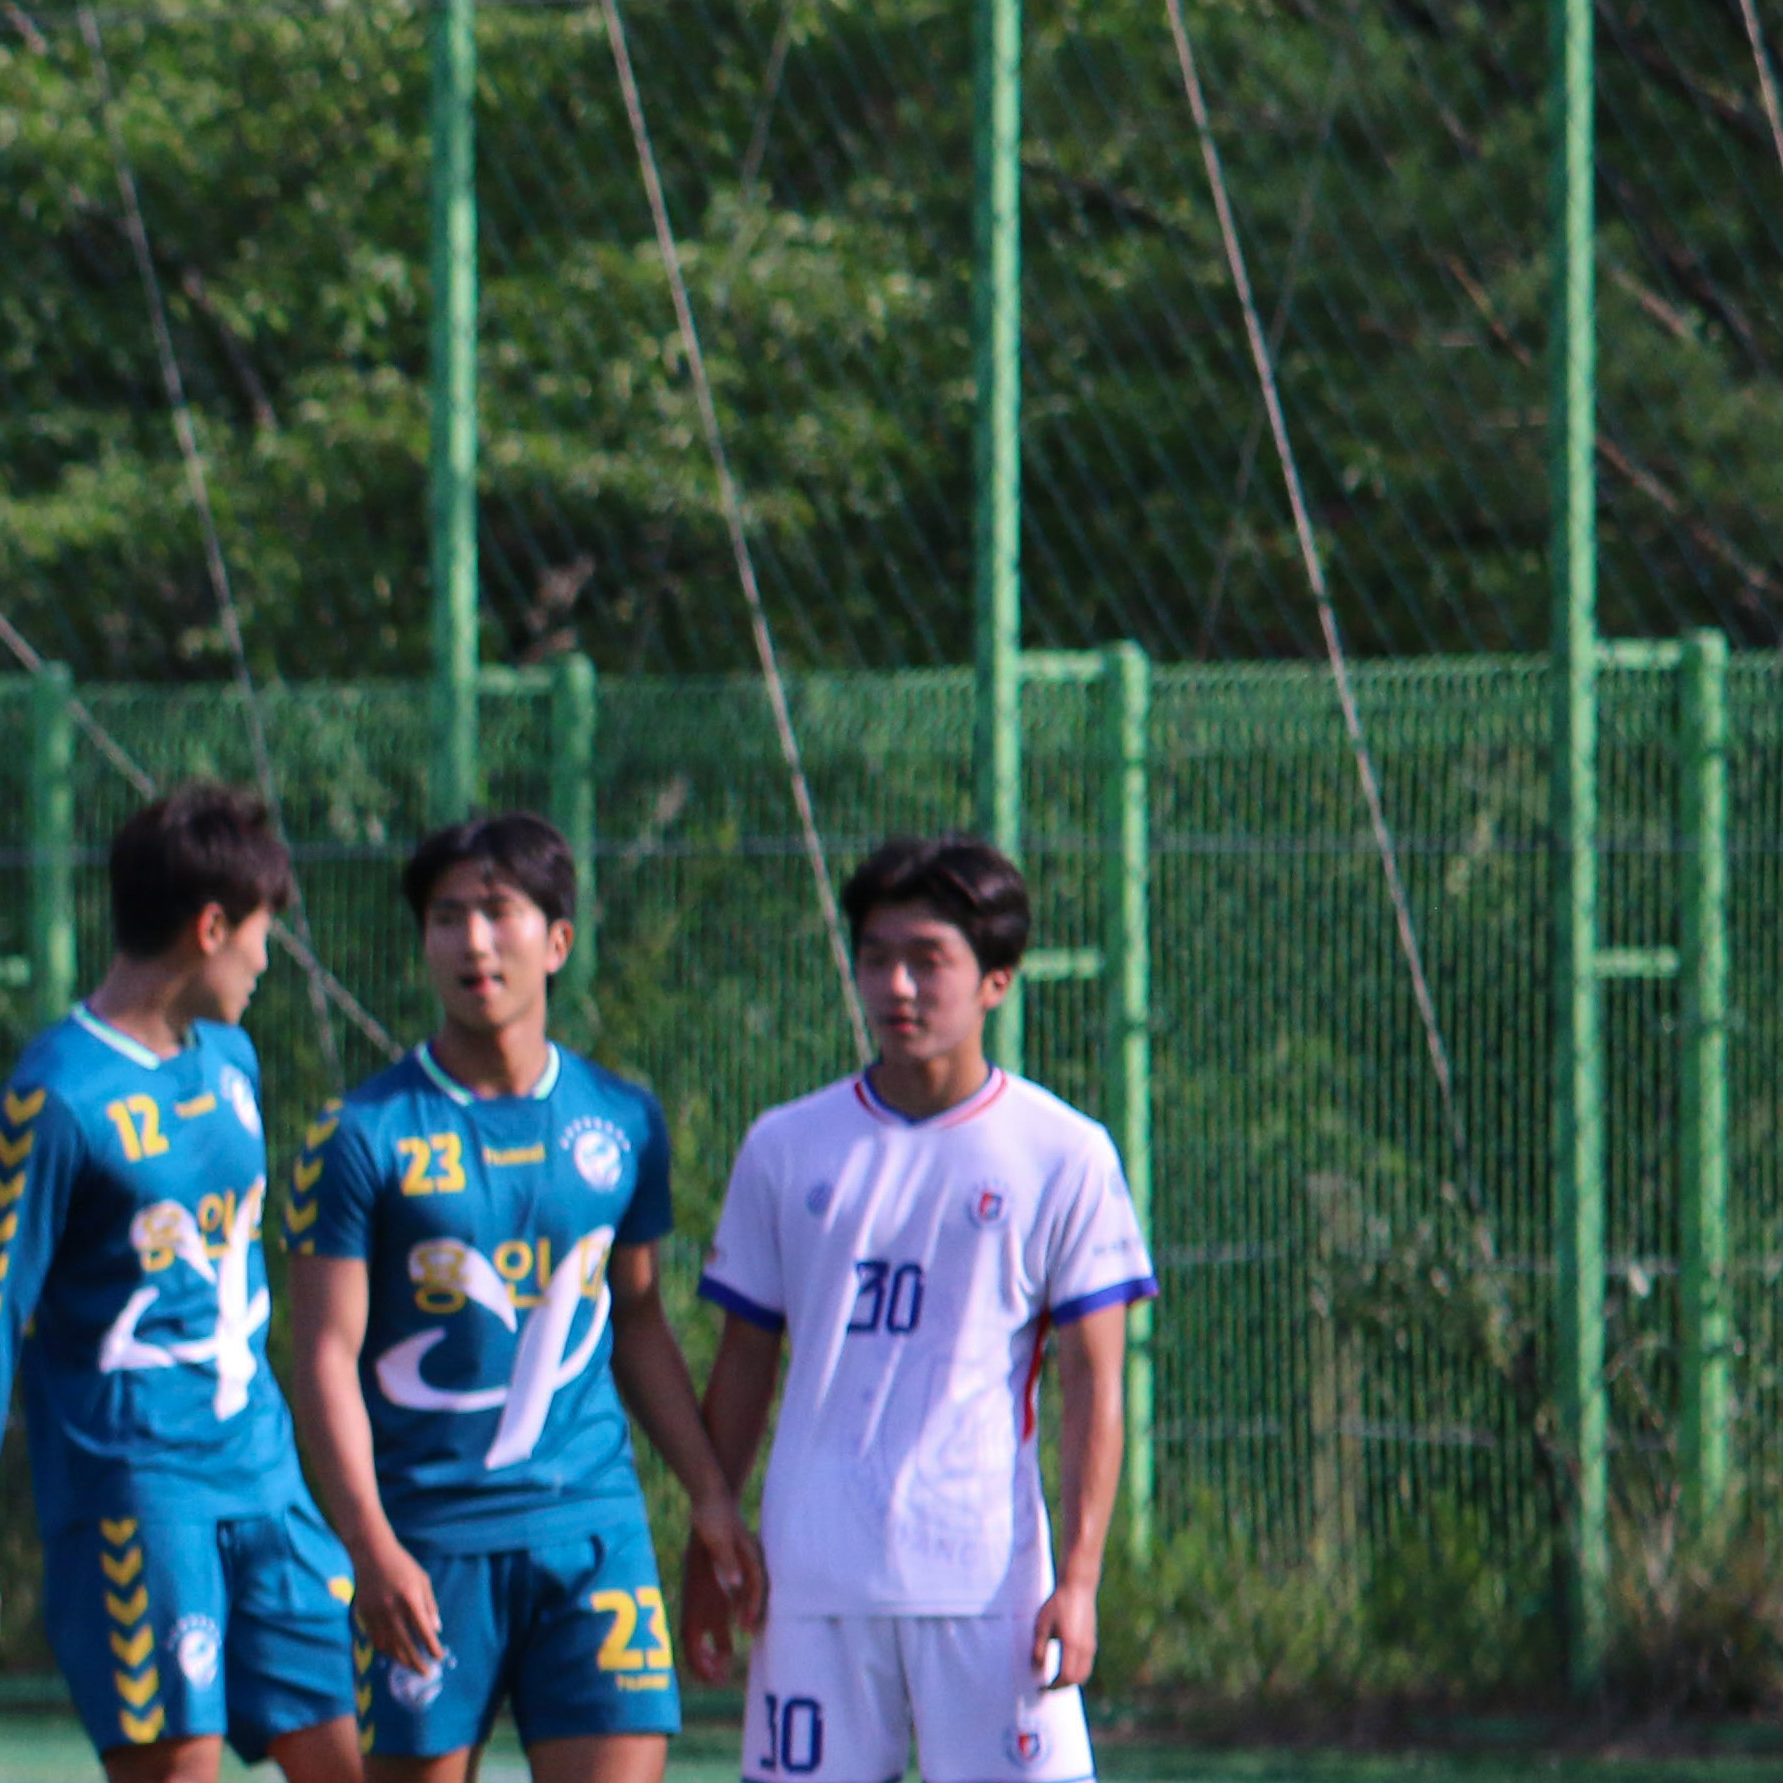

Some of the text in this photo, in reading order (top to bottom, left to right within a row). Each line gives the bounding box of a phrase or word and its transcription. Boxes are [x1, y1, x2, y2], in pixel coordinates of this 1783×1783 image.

[107, 1095, 169, 1162] 12
[398, 1132, 466, 1195] 23
[848, 1260, 925, 1333] 30
[590, 1586, 673, 1671] 23
